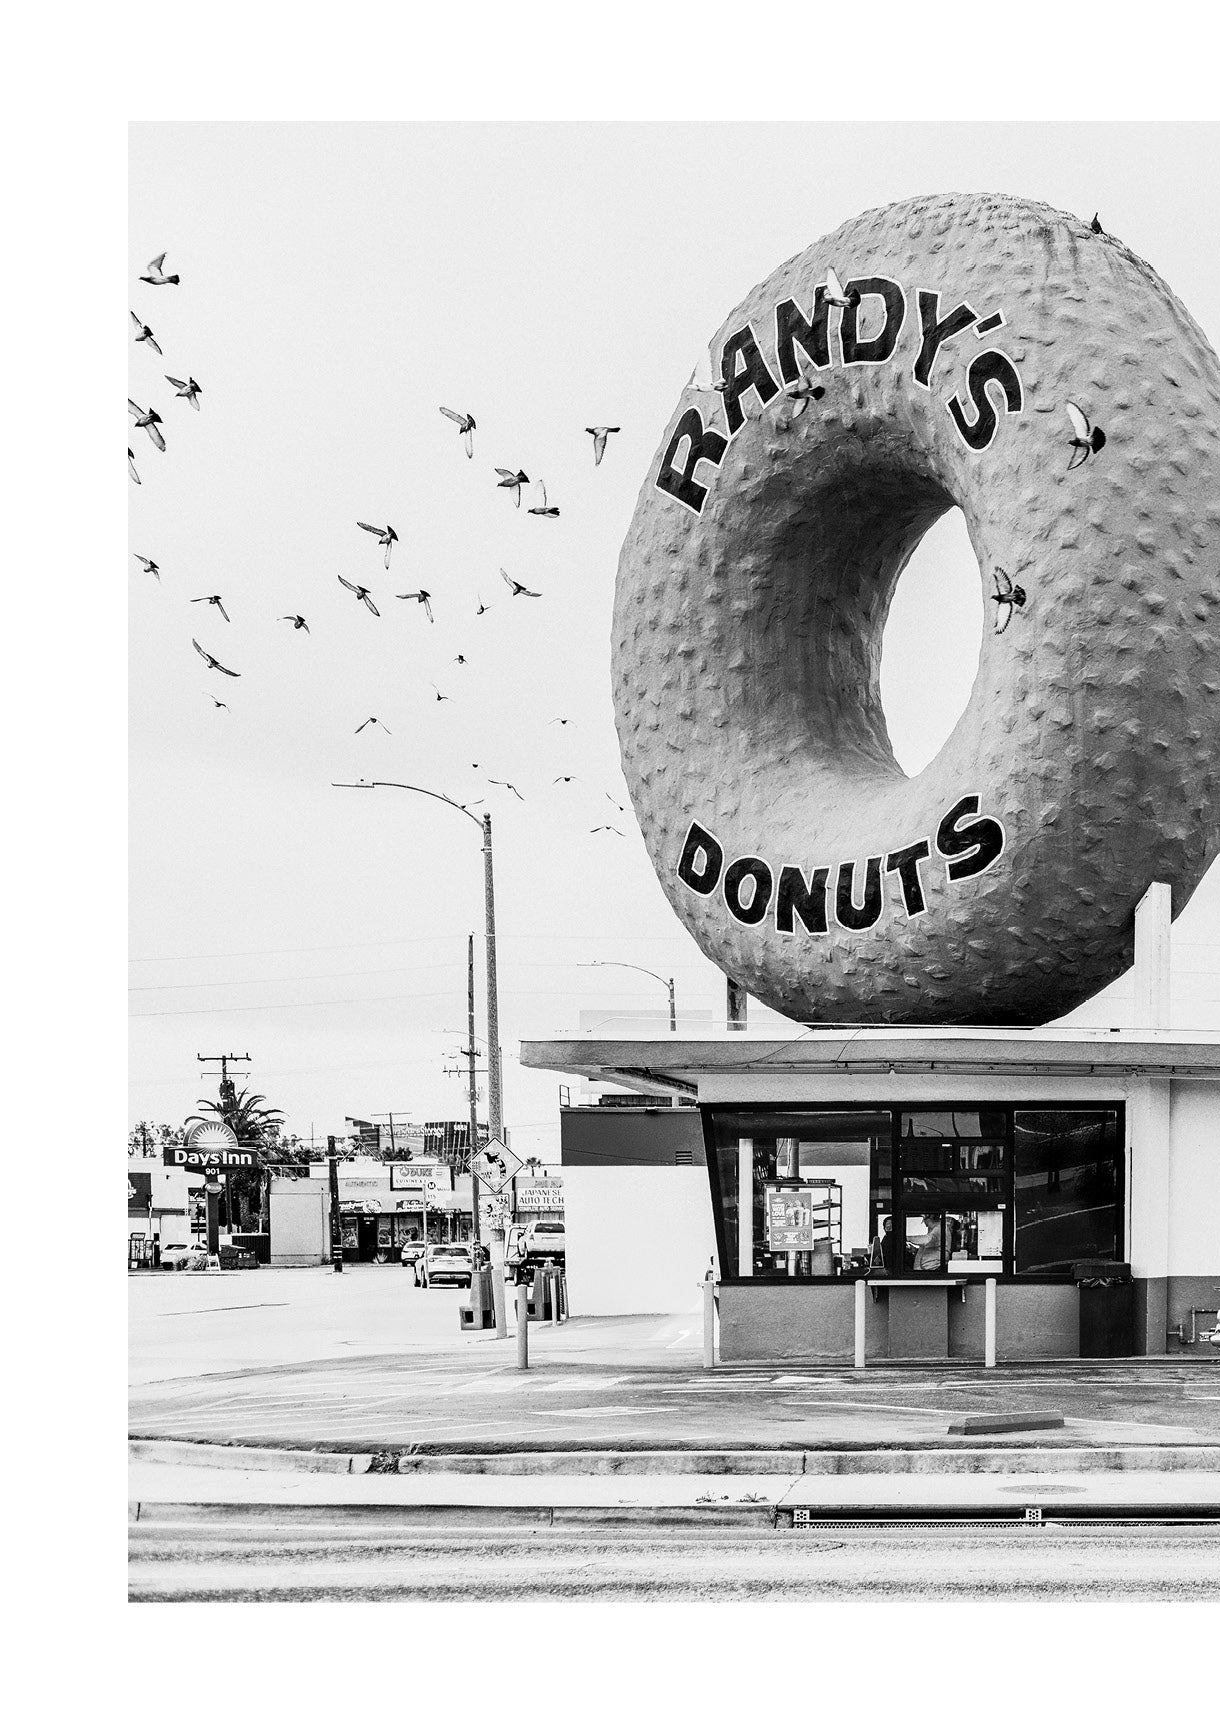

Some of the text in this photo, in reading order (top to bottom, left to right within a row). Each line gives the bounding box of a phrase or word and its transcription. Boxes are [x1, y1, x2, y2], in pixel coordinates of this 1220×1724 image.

[655, 275, 1025, 517] RANDY'S
[677, 792, 1006, 935] DONUTS
[174, 1150, 252, 1165] Days Inn
